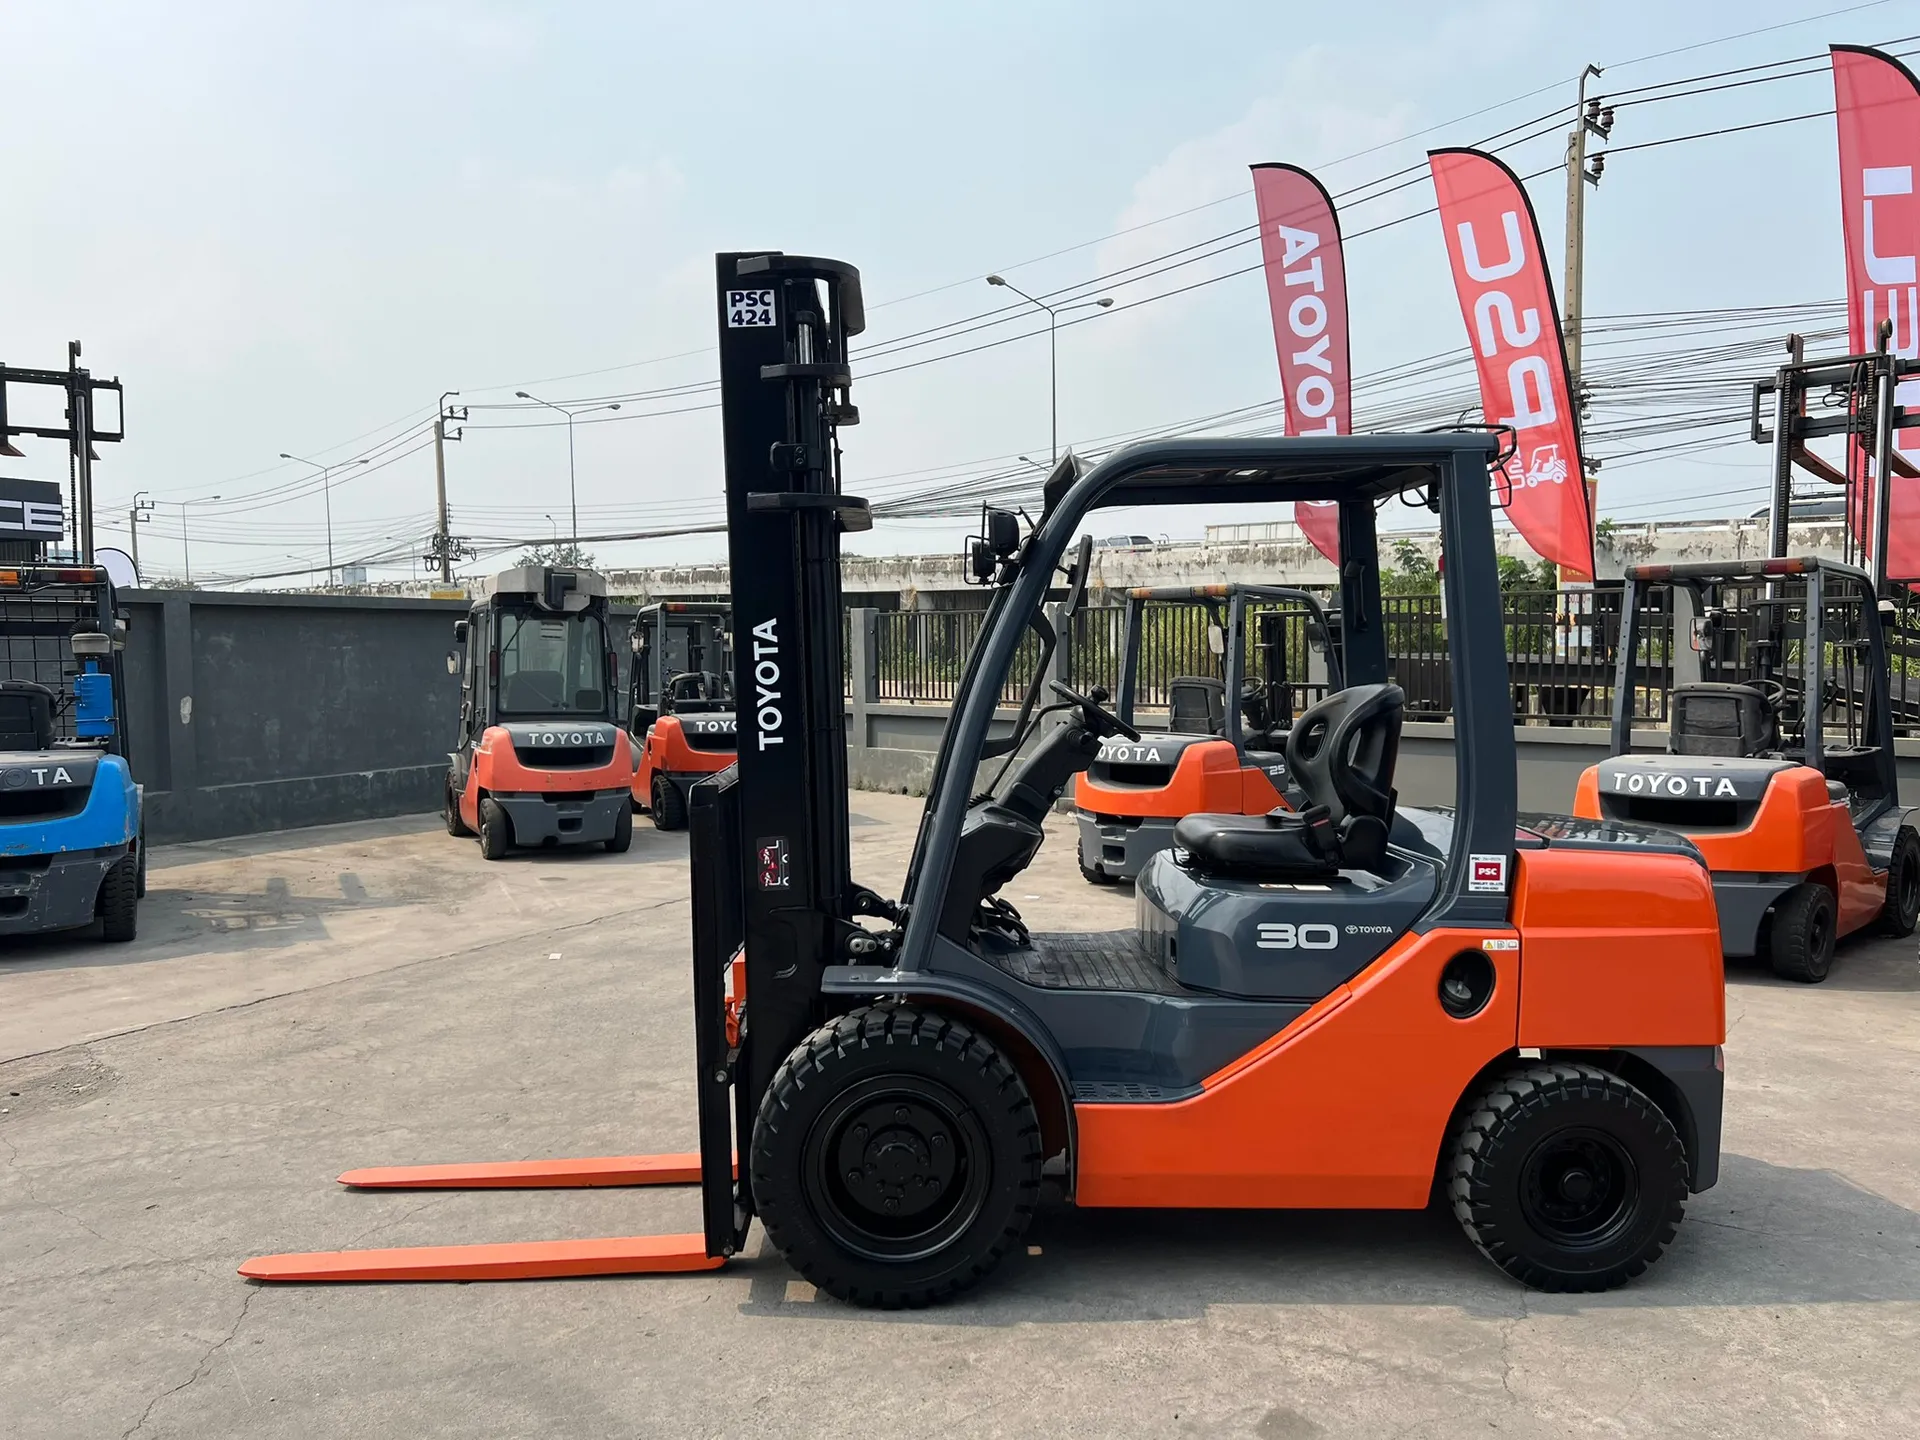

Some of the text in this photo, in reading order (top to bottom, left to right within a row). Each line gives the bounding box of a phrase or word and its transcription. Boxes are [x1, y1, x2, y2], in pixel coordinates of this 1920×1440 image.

[730, 291, 771, 307] PSC
[731, 309, 771, 325] 424
[752, 617, 784, 751] TOYOTA
[528, 732, 605, 745] TOYOTA
[1269, 764, 1285, 775] 25
[1613, 772, 1737, 796] TOYOTA
[1256, 923, 1338, 949] 30
[1358, 926, 1393, 934] TOYOTA
